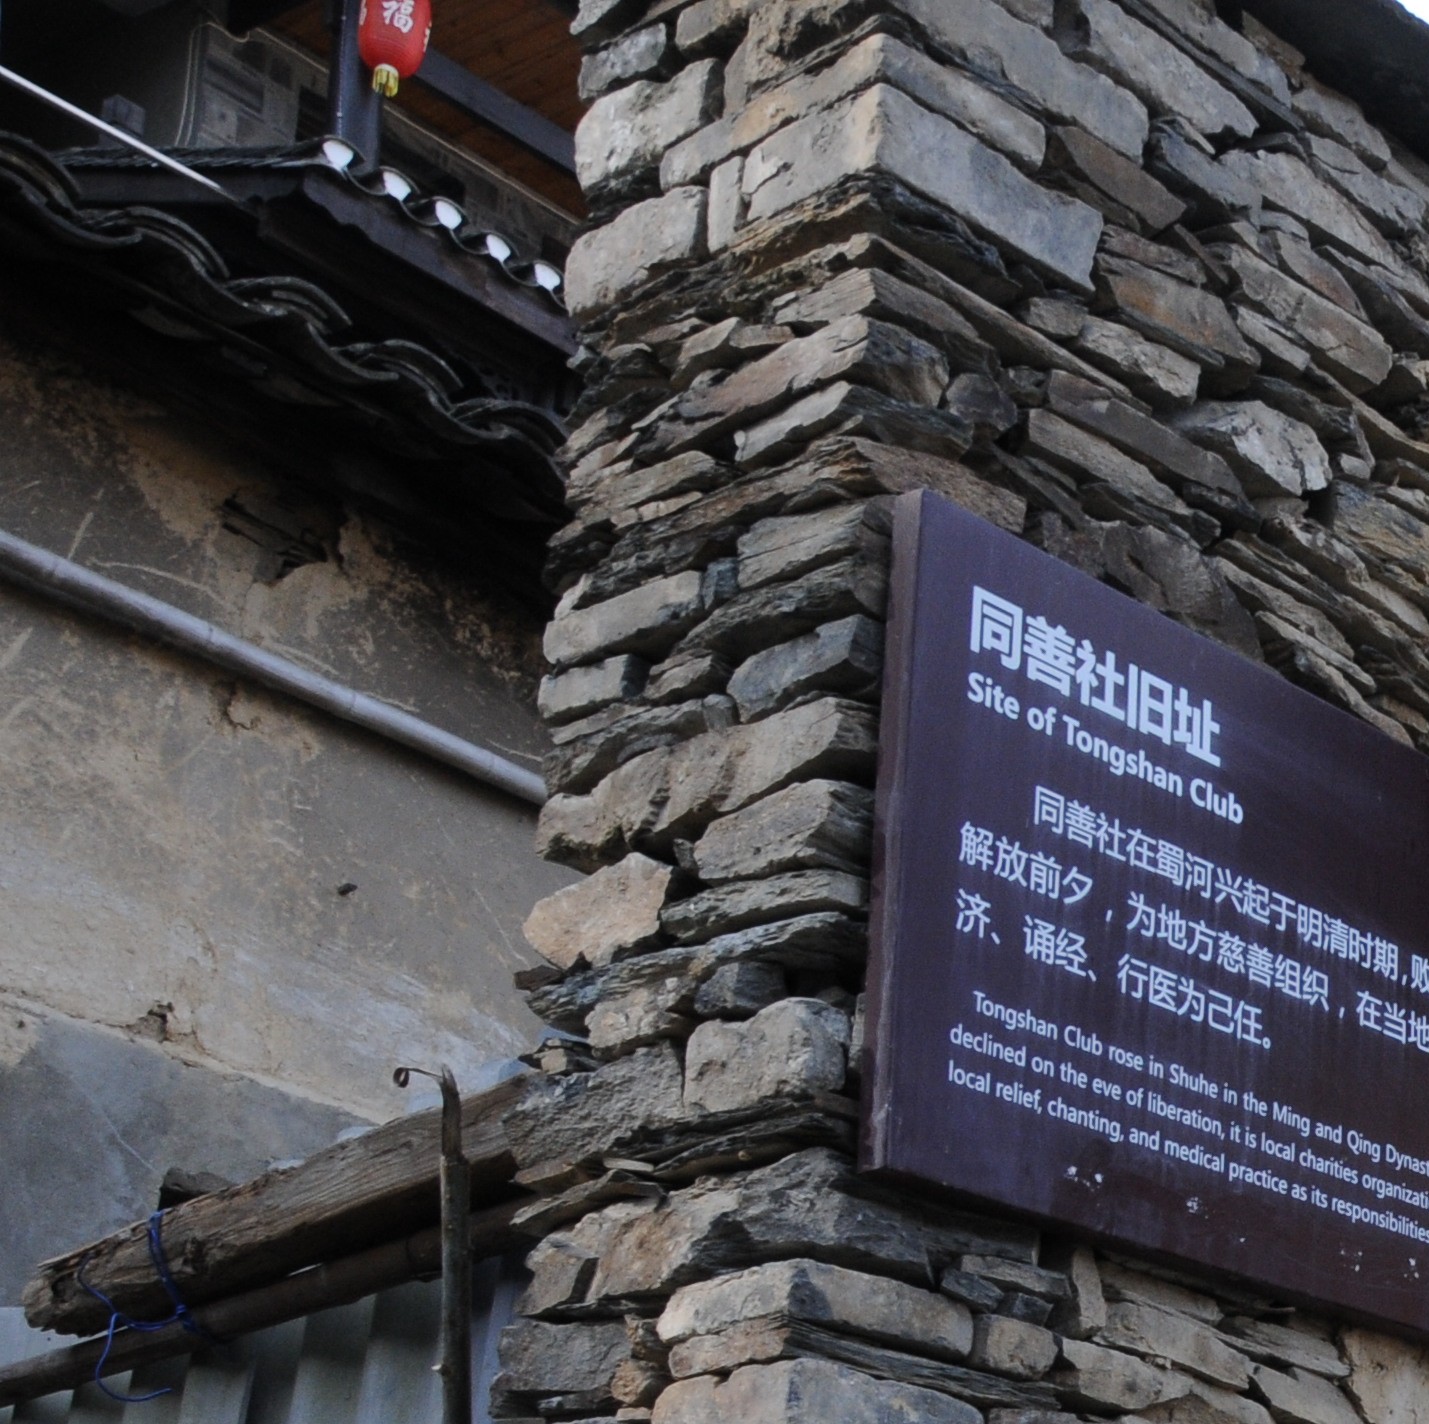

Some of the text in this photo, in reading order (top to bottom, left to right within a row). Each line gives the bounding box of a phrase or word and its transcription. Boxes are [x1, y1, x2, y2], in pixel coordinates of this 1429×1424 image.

[967, 671, 1244, 825] Site of Tongshan Club
[969, 585, 1222, 768] 同善社旧址
[948, 1059, 991, 1094] local
[995, 1081, 1043, 1115] relief,
[1046, 1096, 1125, 1143] chanting,
[1128, 1127, 1161, 1152] and
[1164, 1139, 1225, 1173] medical
[1228, 1161, 1289, 1195] practice
[1290, 1183, 1308, 1202] as
[1310, 1184, 1329, 1209] its
[949, 1023, 1027, 1068] declined
[1030, 1056, 1055, 1078] on
[1059, 1061, 1088, 1089] the
[1091, 1077, 1122, 1101] eve
[1125, 1087, 1145, 1109] of
[1147, 1090, 1226, 1141] liberation,
[1229, 1120, 1241, 1144] it
[1244, 1126, 1257, 1149] is
[1260, 1131, 1296, 1163] local
[1298, 1148, 1359, 1185] charities
[972, 990, 1058, 1041] Tongshan
[1063, 1025, 1104, 1056] Club
[1108, 1045, 1144, 1072] rose
[1148, 1054, 1164, 1079] in
[1168, 1063, 1219, 1099] Shuhe
[1223, 1082, 1238, 1106] in
[1242, 1091, 1268, 1117] the
[1272, 1101, 1311, 1138] Ming
[1314, 1122, 1343, 1145] and
[1346, 1129, 1381, 1163] Qing
